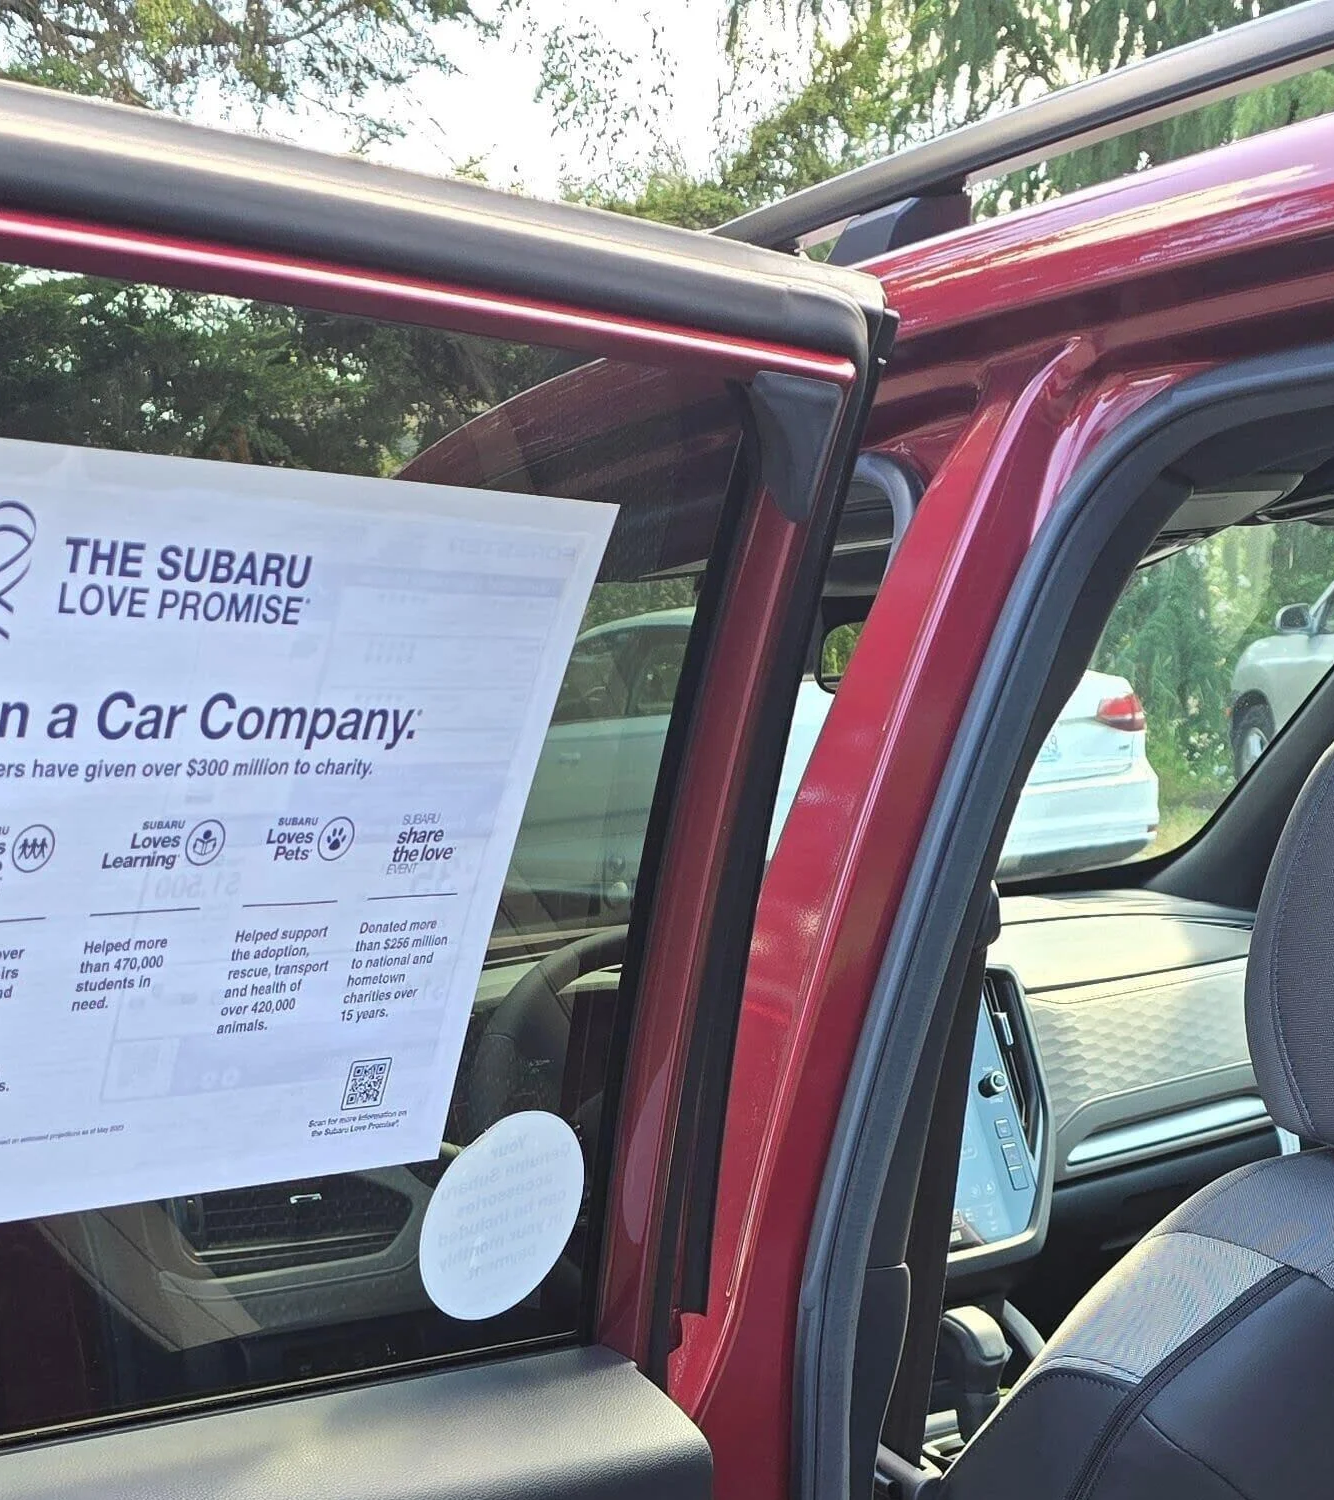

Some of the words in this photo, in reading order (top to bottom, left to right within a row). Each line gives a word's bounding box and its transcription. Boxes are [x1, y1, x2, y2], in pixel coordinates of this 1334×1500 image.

[66, 537, 145, 578] THE
[158, 546, 312, 588] SUBARU
[59, 582, 149, 617] LOVE
[47, 704, 77, 738] a
[98, 692, 187, 740] Car
[201, 693, 418, 750] Company.
[32, 759, 79, 777] have
[85, 760, 136, 782] given
[143, 763, 182, 776] over
[187, 758, 229, 778] $300
[233, 758, 289, 776] million
[294, 759, 310, 774] to
[315, 758, 372, 779] charity.
[143, 820, 186, 830] SUBARU
[278, 817, 319, 826] SUBARU
[403, 813, 441, 825] SUBARU
[131, 833, 181, 849] Loves
[267, 829, 314, 844] Loves
[397, 828, 444, 844] share
[102, 851, 177, 869] Learning
[274, 846, 309, 861] Pets
[386, 864, 417, 874] EVENT
[360, 920, 407, 934] Donated
[409, 920, 437, 932] more
[235, 928, 279, 944] Helped
[281, 927, 328, 941] support
[356, 940, 380, 952] than
[384, 937, 409, 950] $256
[412, 935, 448, 947] million
[84, 938, 131, 956] Helped
[134, 938, 168, 950] more
[232, 949, 250, 961] the
[254, 945, 309, 960] adoption,
[80, 960, 109, 973] than
[114, 955, 163, 972] 470,000
[351, 958, 362, 969] to
[366, 954, 410, 968] national
[413, 952, 434, 964] and
[228, 967, 271, 980] rescue,
[275, 960, 329, 975] transport
[76, 977, 134, 992] students
[139, 975, 150, 988] in
[347, 973, 405, 987] hometown
[224, 985, 247, 998] and
[251, 981, 286, 996] health
[290, 979, 303, 991] of
[343, 990, 391, 1004] charities
[394, 989, 418, 999] over
[72, 996, 108, 1011] need.
[221, 1006, 248, 1016] over
[251, 998, 296, 1014] 420,000
[341, 1010, 354, 1022] 15
[356, 1008, 388, 1023] years.
[217, 1019, 268, 1034] animals.
[324, 1127, 348, 1135] Subaru
[351, 1124, 366, 1132] Love
